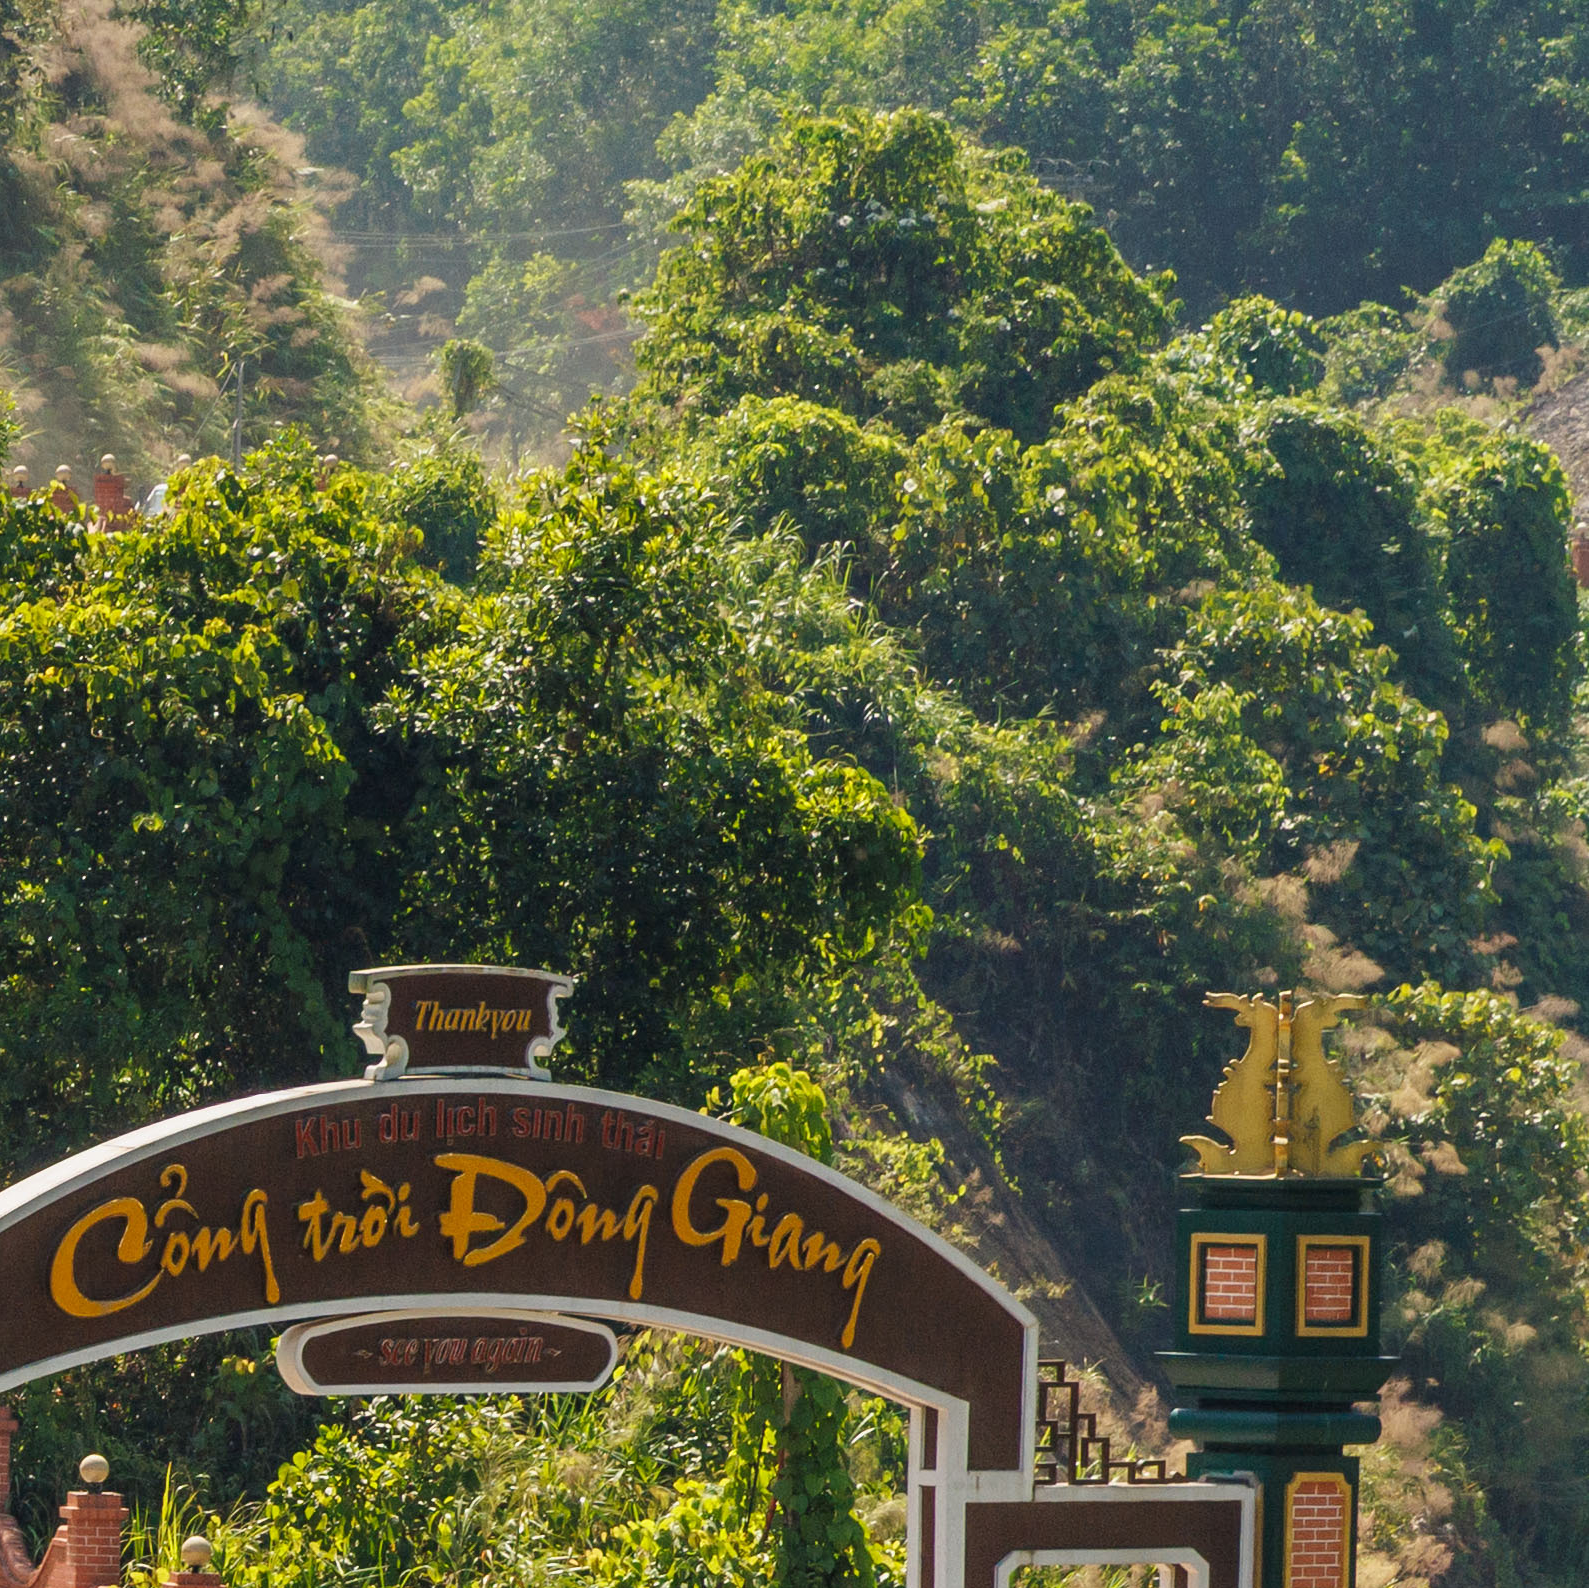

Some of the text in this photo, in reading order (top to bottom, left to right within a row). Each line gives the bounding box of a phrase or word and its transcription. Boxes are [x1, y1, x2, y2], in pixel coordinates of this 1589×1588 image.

[295, 1097, 666, 1160] Khu du lịch sinh thái
[50, 1147, 881, 1349] Cổng trời Đông Giang
[379, 1328, 544, 1374] see you again
